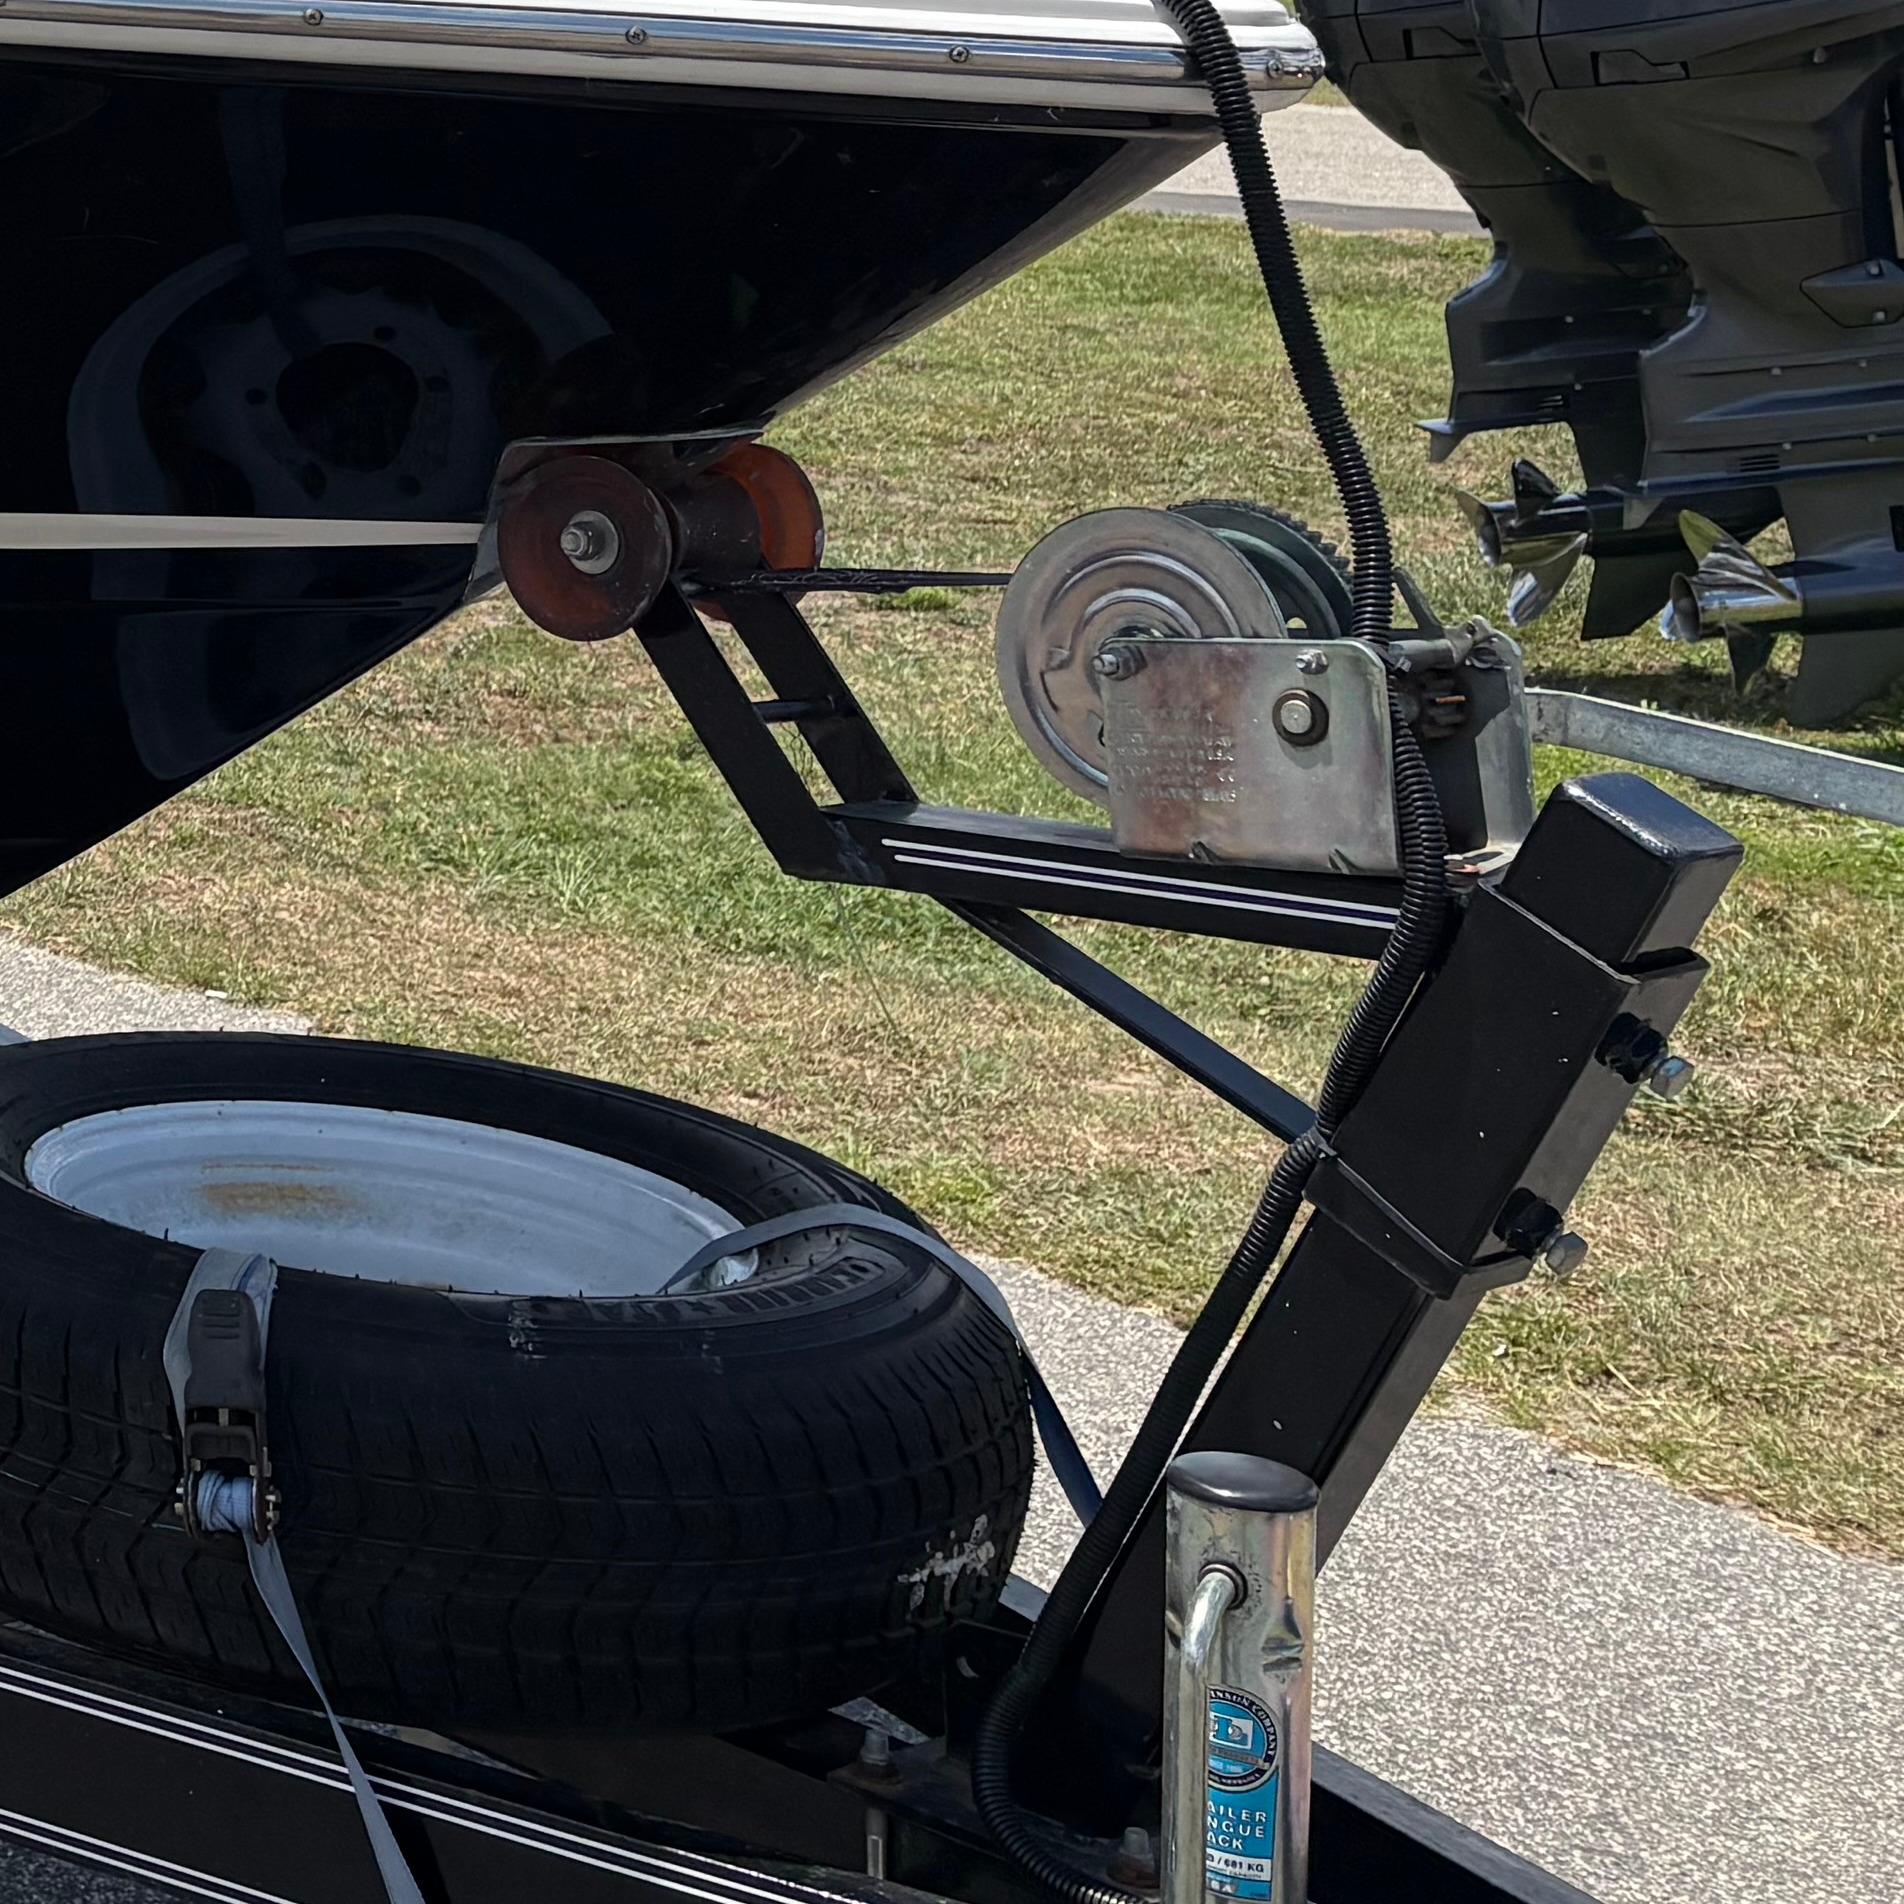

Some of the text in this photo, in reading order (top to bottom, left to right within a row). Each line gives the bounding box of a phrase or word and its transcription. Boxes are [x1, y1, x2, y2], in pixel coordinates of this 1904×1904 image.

[1207, 1800, 1267, 1823] AILER
[1207, 1815, 1265, 1838] NGUE
[1207, 1831, 1243, 1850] ACK
[1247, 1863, 1264, 1873] KG
